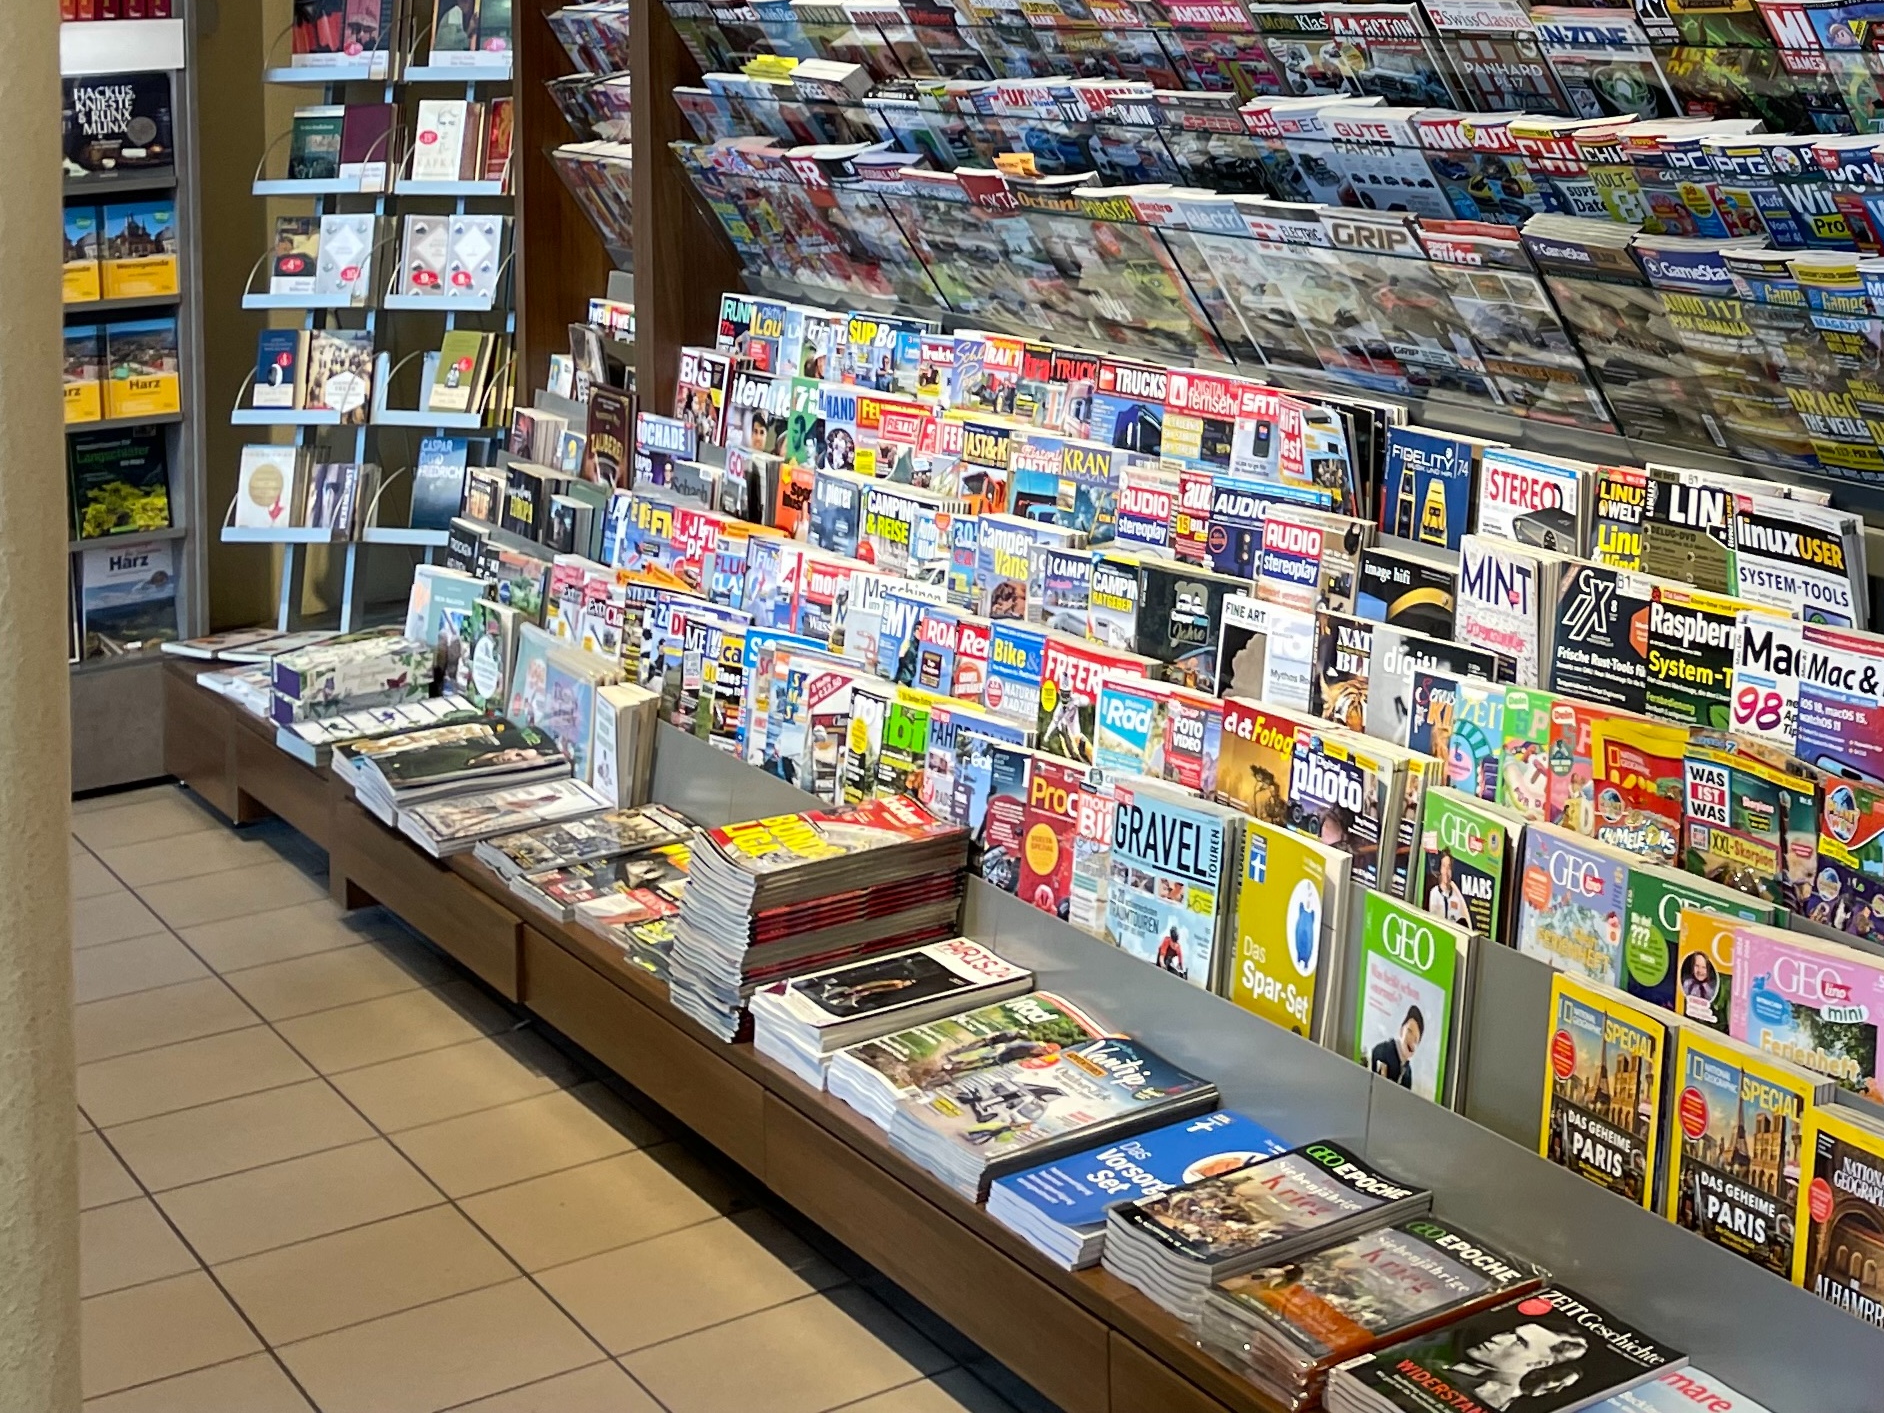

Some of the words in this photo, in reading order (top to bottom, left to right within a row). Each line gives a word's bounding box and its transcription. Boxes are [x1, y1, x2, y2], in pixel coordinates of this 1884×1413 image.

[1464, 62, 1543, 78] PANHARD
[75, 98, 133, 112] KNIESTE
[90, 107, 132, 123] RUNX
[1116, 368, 1166, 399] TRUCKS
[420, 439, 454, 454] CASPAR
[1392, 445, 1454, 470] FIDELITY
[418, 465, 463, 480] FRIEDRICH
[1063, 448, 1110, 477] KRAN
[1266, 524, 1321, 555] AUDIO
[1737, 515, 1844, 570] linuxUSER
[109, 553, 149, 571] Harz
[1263, 554, 1318, 582] stereoplay
[1461, 554, 1531, 615] MINT
[1740, 567, 1849, 607] SYSTEM-TOOLS
[1225, 601, 1245, 617] FINE
[1247, 606, 1266, 622] ART
[1808, 652, 1856, 688] Mac
[1858, 666, 1879, 693] &
[1734, 687, 1781, 728] 98
[1175, 717, 1203, 738] FOTO
[1173, 734, 1201, 752] VIDEO
[1291, 754, 1362, 813] photo
[1690, 768, 1725, 788] WAS
[1696, 789, 1721, 805] IST
[1116, 802, 1210, 877] GRAVEL
[1208, 829, 1220, 880] TOUREN
[1244, 936, 1266, 964] Das
[1382, 913, 1434, 970] GEO
[1242, 961, 1308, 1024] Spar-Set
[1827, 1005, 1864, 1023] mini
[1741, 1078, 1800, 1122] SPECIAL
[1700, 1171, 1726, 1194] DAS
[1727, 1182, 1777, 1218] GEHEIME
[1707, 1196, 1767, 1246] PARIS
[1436, 1232, 1522, 1284] EPOCHE
